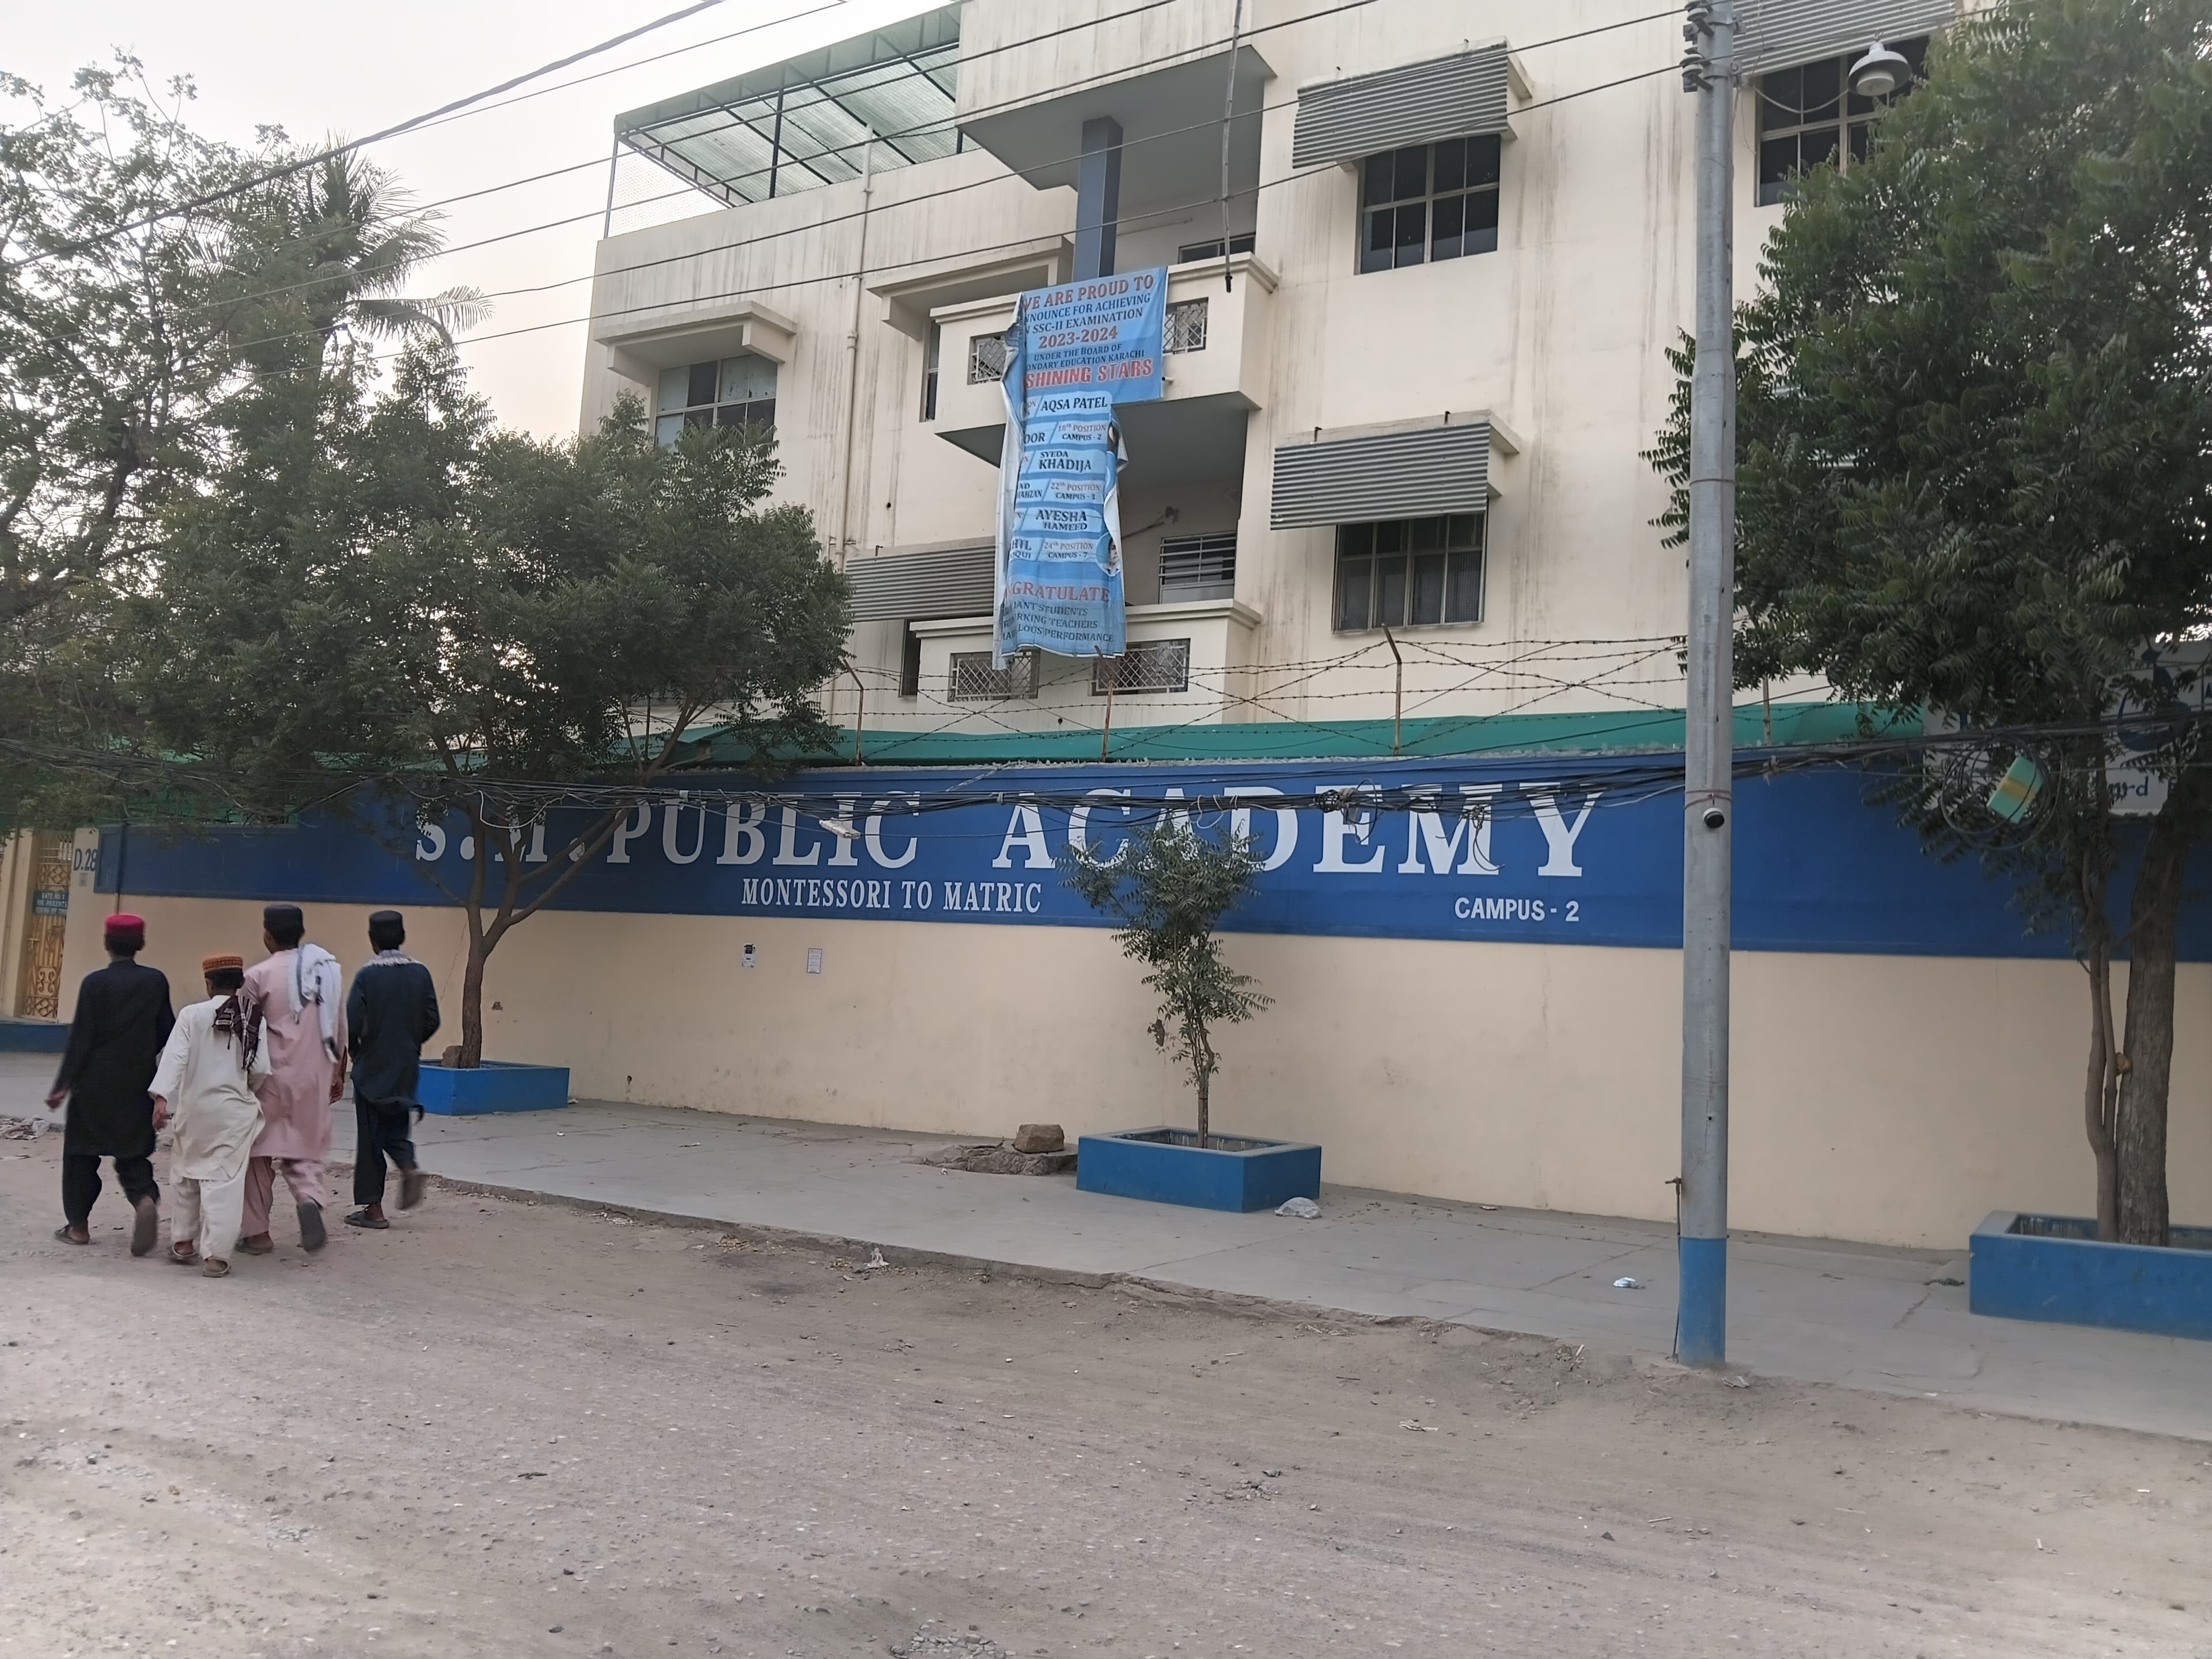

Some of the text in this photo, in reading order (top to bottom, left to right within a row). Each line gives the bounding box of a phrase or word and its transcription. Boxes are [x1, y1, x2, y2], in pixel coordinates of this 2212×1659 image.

[1044, 291, 1073, 307] ARE
[1077, 279, 1128, 301] PROUD
[1134, 274, 1154, 289] TO
[1073, 305, 1093, 316] FOR
[1094, 293, 1151, 312] ACHIEVING
[1033, 321, 1063, 334] SSC-II
[1066, 308, 1143, 329] EXAMINATION
[1039, 325, 1118, 349] 2023-2024
[1034, 344, 1122, 362] UNDER THE BOARD OF
[1060, 355, 1106, 368] EDUCATION
[1108, 350, 1145, 362] KARACHI
[1025, 358, 1153, 389] SHINING STARS
[1041, 398, 1071, 412] AQSA
[1073, 396, 1107, 410] PATEL
[1073, 423, 1107, 432] POSITION
[1062, 433, 1092, 441] CAMPUS
[1039, 459, 1092, 473] KHADIJA
[1067, 483, 1101, 492] POSITION
[1036, 509, 1088, 521] AYESHA
[1043, 522, 1088, 531] HAMEED
[1060, 542, 1094, 550] POSITION
[1039, 605, 1088, 616] STUDENTS
[1048, 618, 1099, 629] TEACHERS
[1045, 629, 1114, 643] PERFORMANCE
[607, 790, 920, 868] PUBLIC
[992, 782, 1607, 876] ACADEMY
[741, 878, 1041, 913] MONTESSORI TO MATRIC
[1455, 897, 1546, 921] CAMPUS
[1565, 901, 1580, 922] 2
